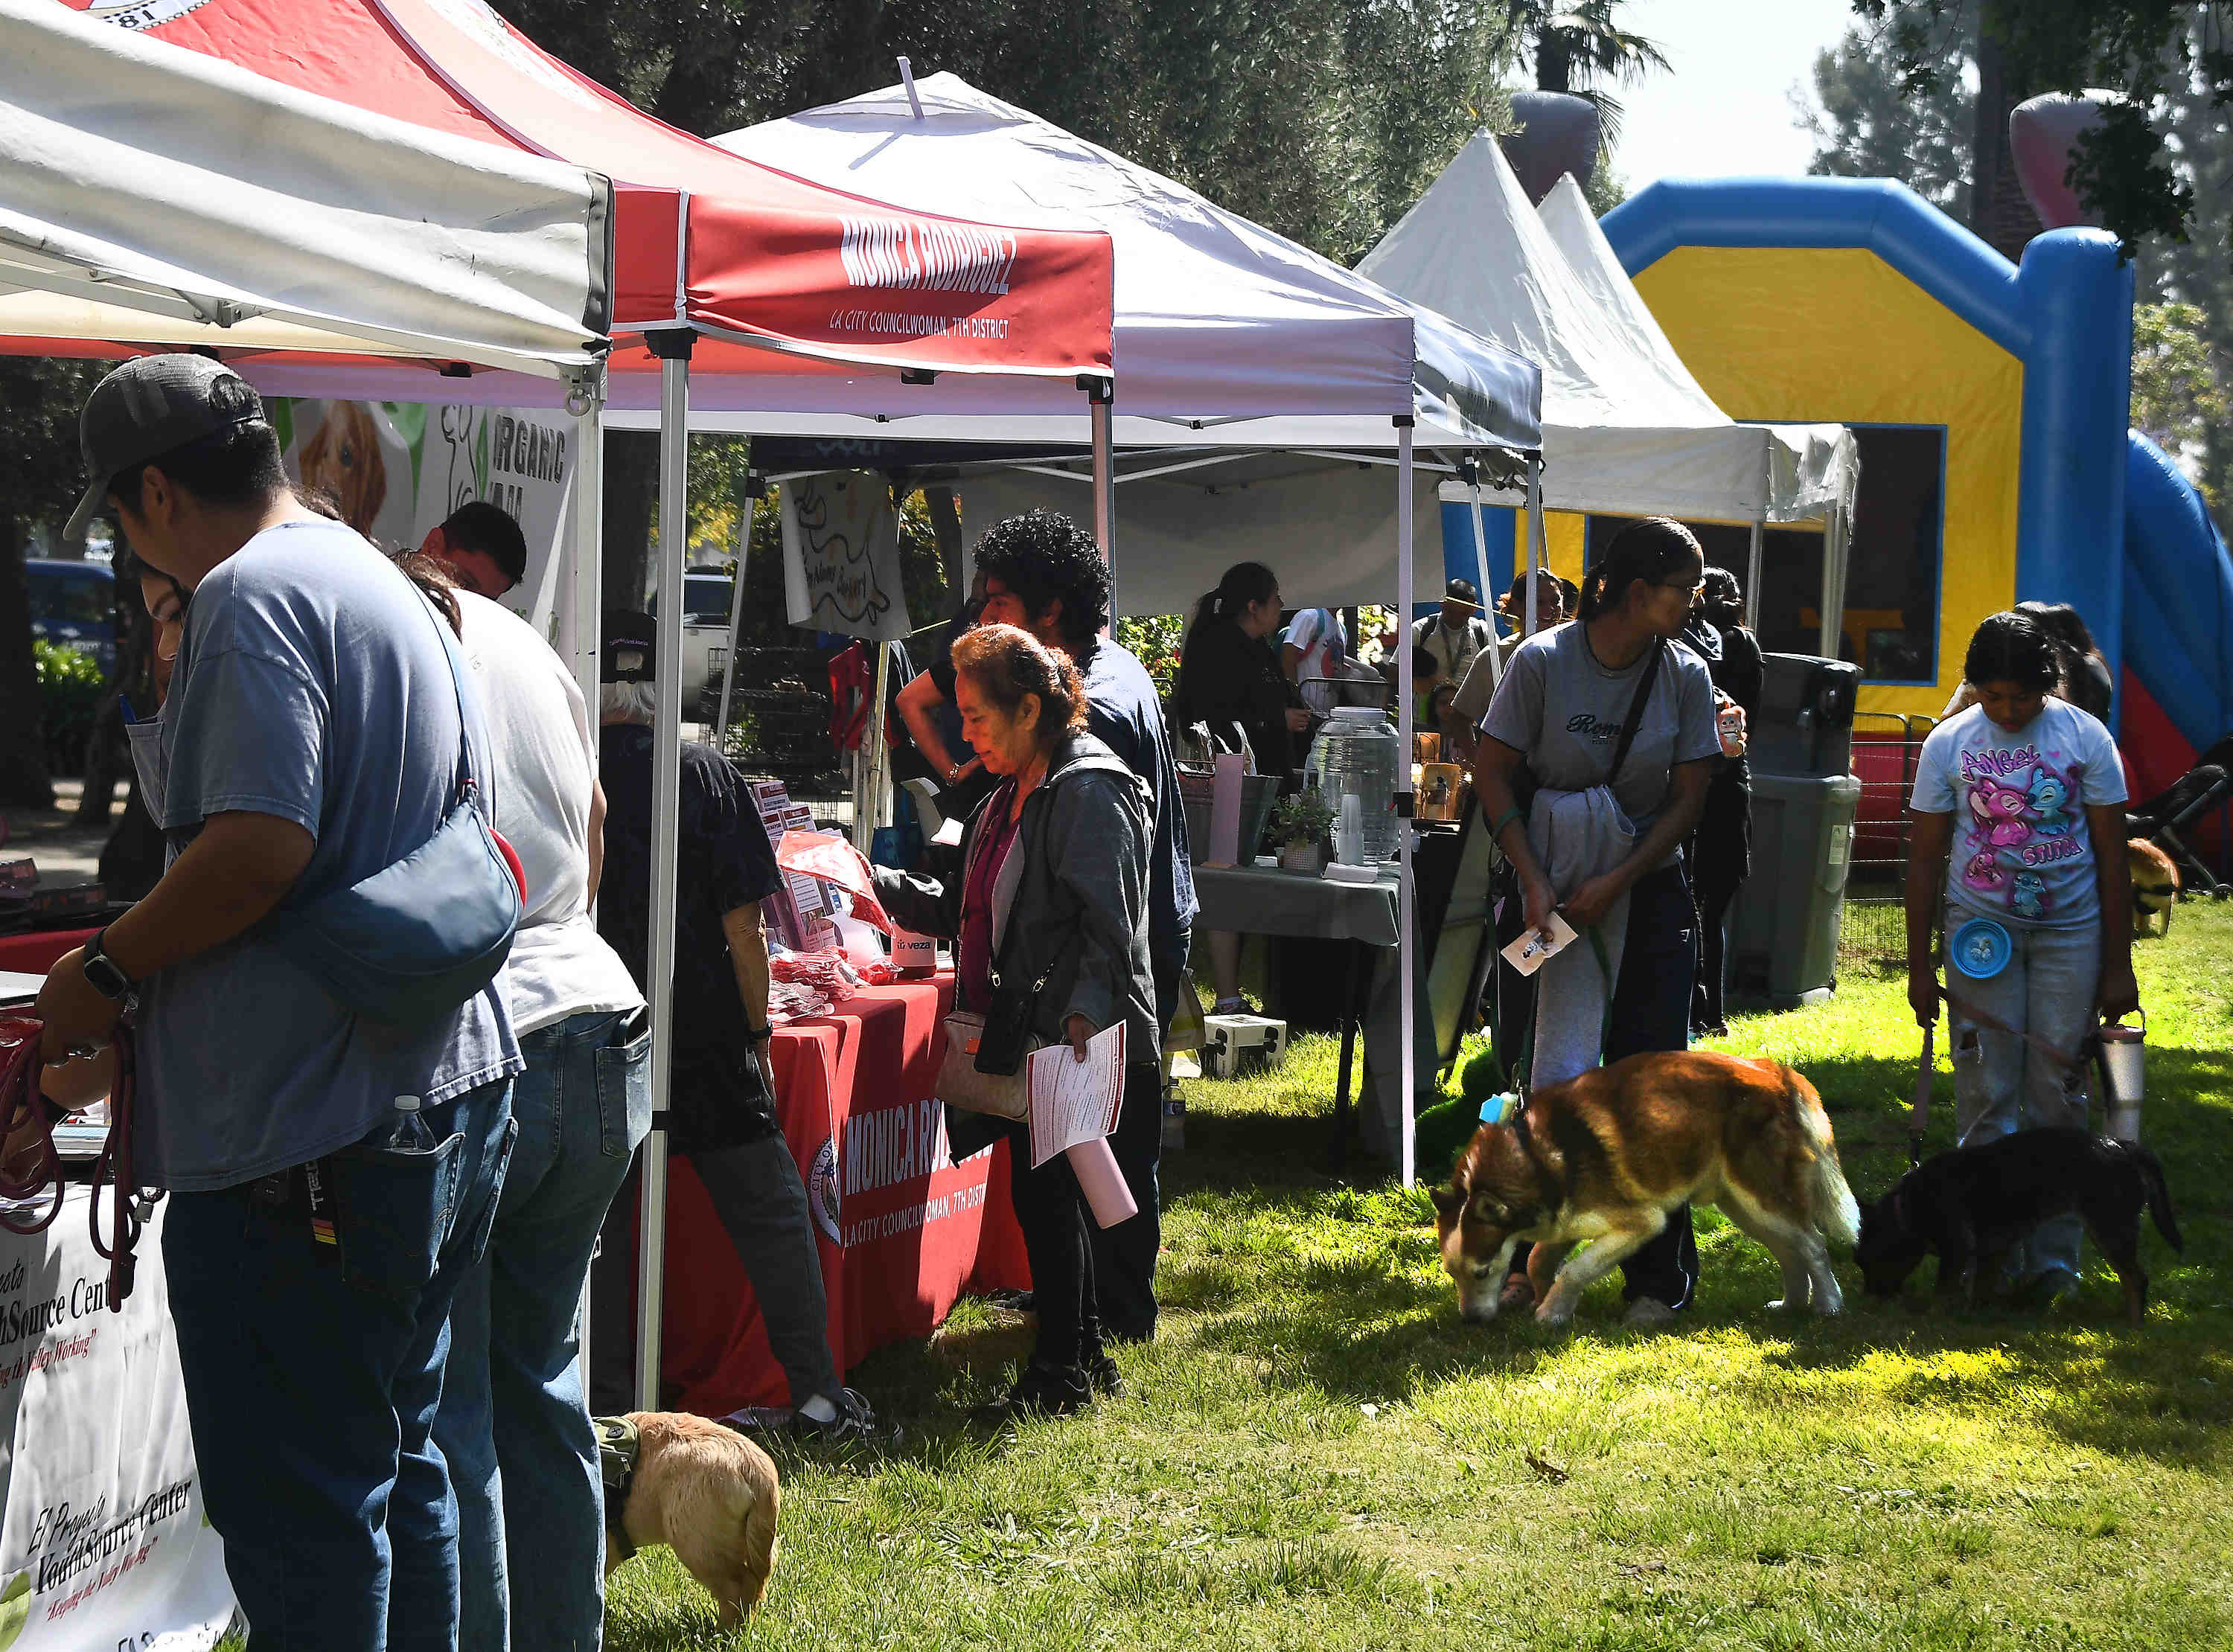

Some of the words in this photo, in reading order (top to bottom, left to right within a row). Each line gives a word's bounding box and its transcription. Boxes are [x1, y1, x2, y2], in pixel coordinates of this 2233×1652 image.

[839, 219, 921, 290] MONICA
[918, 223, 1018, 295] RODRIGUEZ
[829, 309, 843, 329] LA
[845, 310, 869, 331] CITY
[869, 310, 951, 339] COUNCILWOMAN,
[952, 316, 970, 337] 7TH
[971, 318, 1009, 339] DISTRICT
[493, 414, 566, 484] RGANIC
[1961, 743, 2041, 783] ANGEL
[907, 941, 930, 950] veza
[846, 1104, 915, 1196] MONICA
[844, 1226, 857, 1248] LA
[858, 1217, 879, 1243] CITY
[882, 1196, 951, 1238] COUNCILWOMAN,
[953, 1188, 967, 1214] 7TH
[71, 1269, 110, 1319] Cent
[27, 1505, 54, 1556] El
[53, 1488, 106, 1553] Proyecto
[140, 1479, 192, 1531] Center
